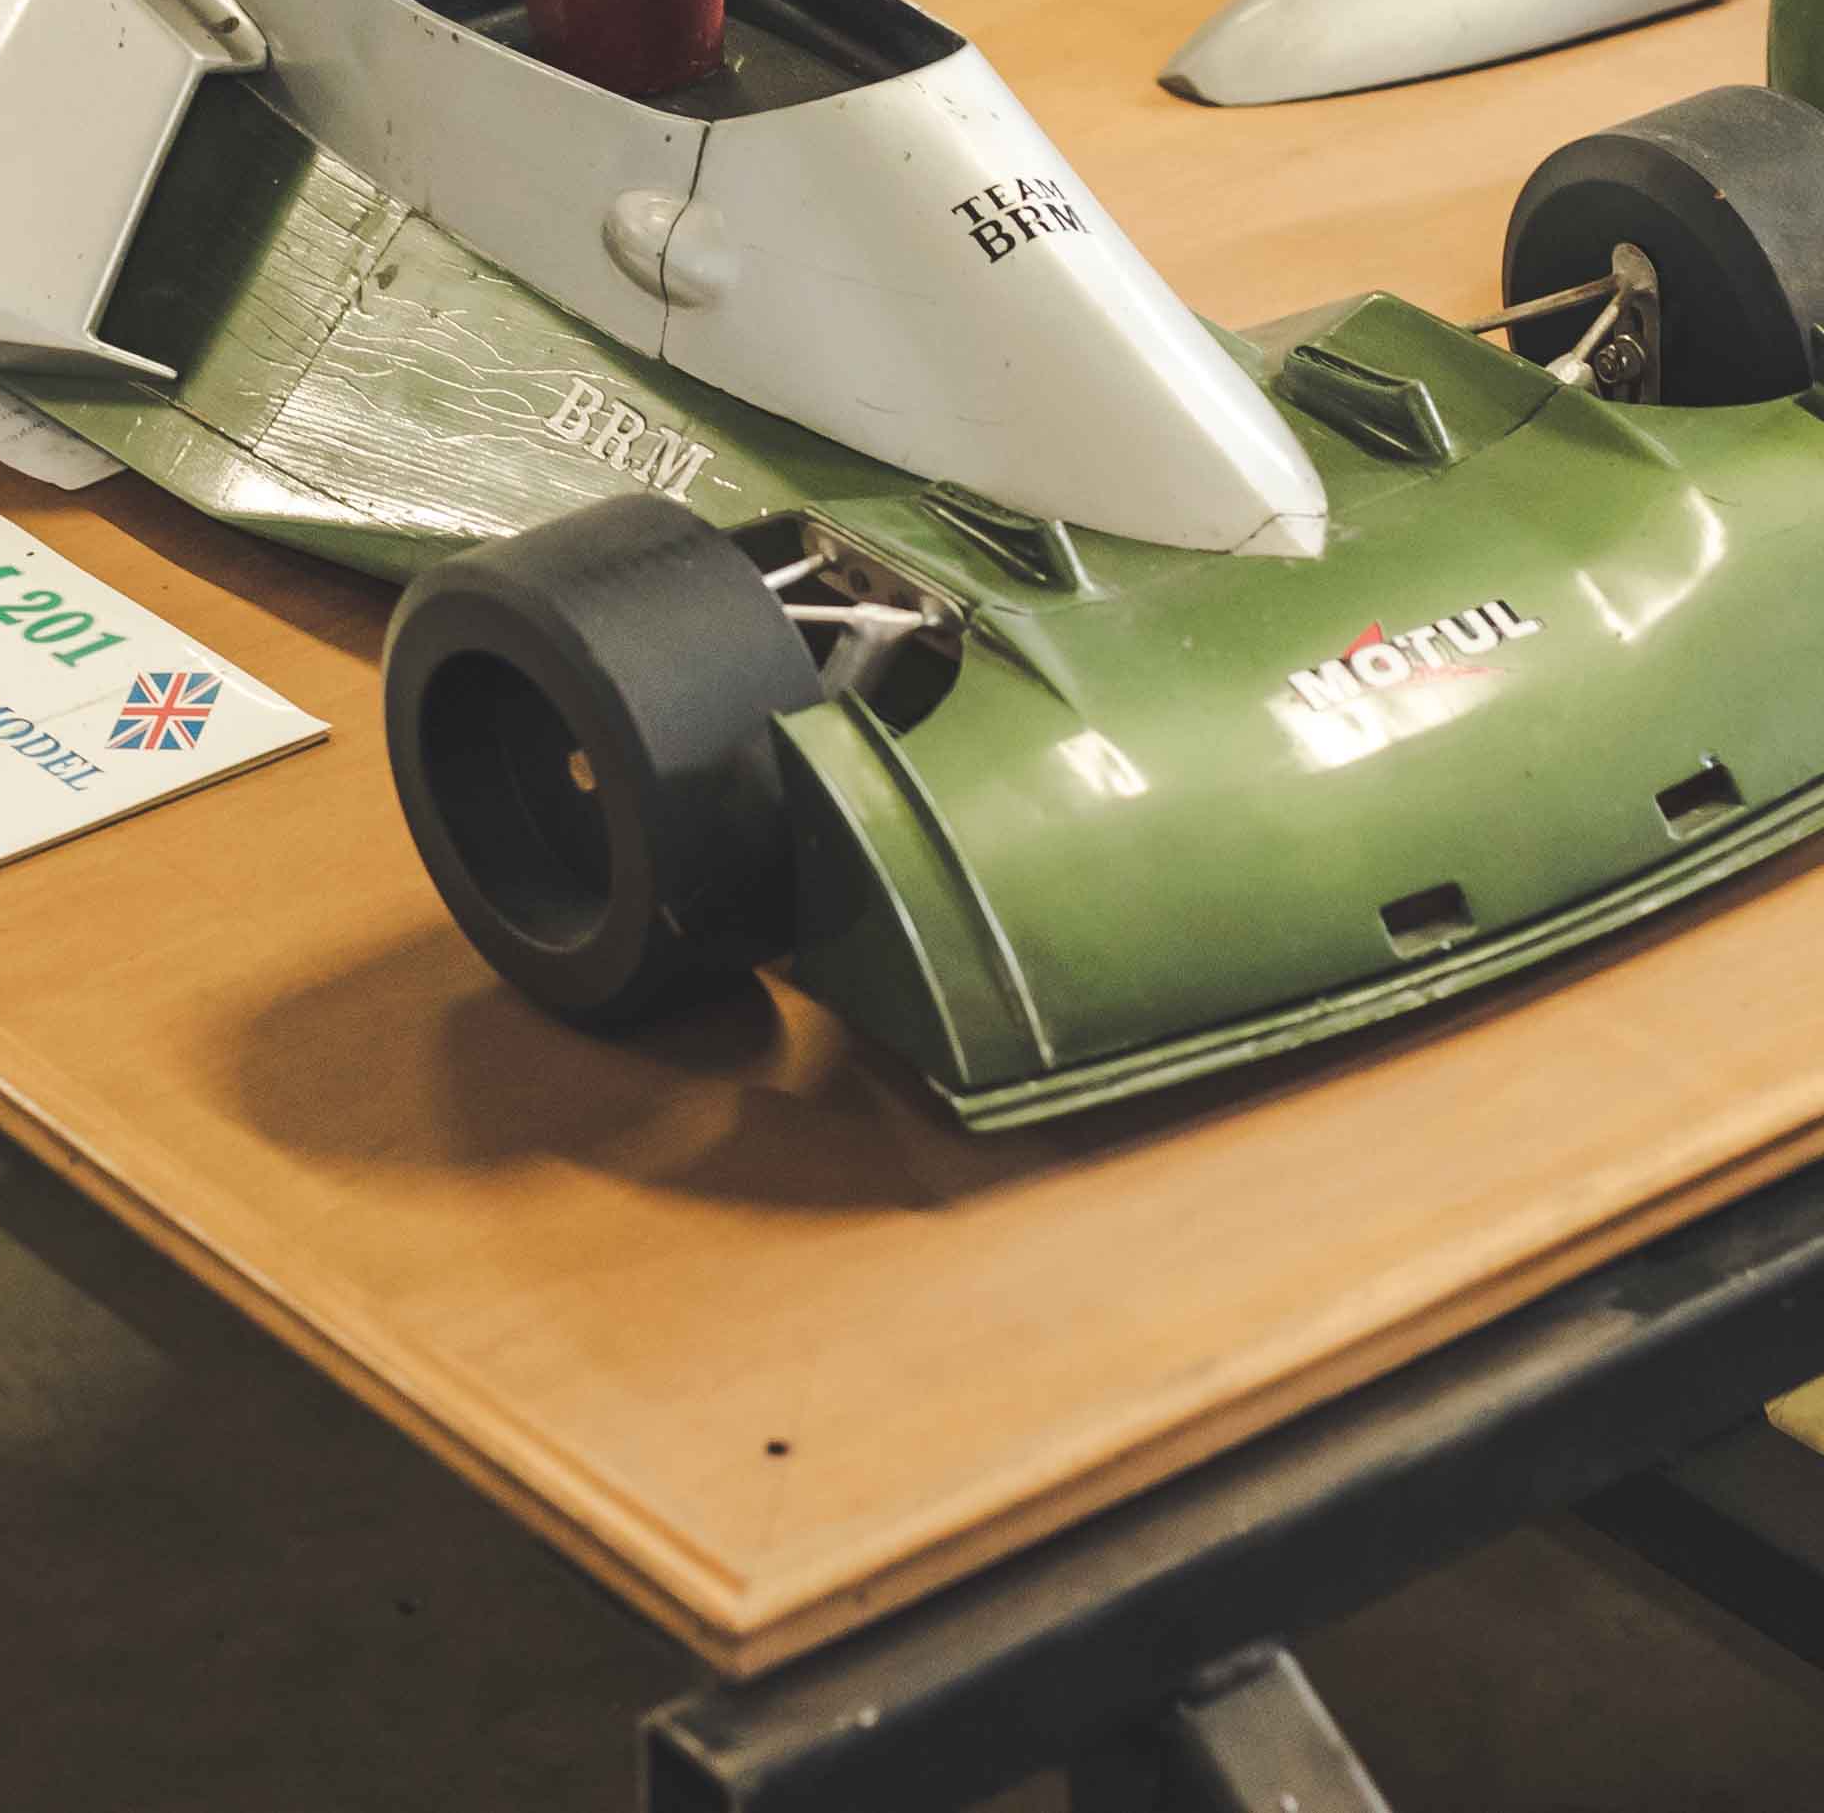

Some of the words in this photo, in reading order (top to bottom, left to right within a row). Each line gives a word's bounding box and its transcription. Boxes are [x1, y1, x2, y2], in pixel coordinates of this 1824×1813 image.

[951, 178, 1066, 225] TEAM
[969, 203, 1091, 264] BRM
[543, 376, 717, 503] BRM
[1287, 599, 1547, 712] MOTUL
